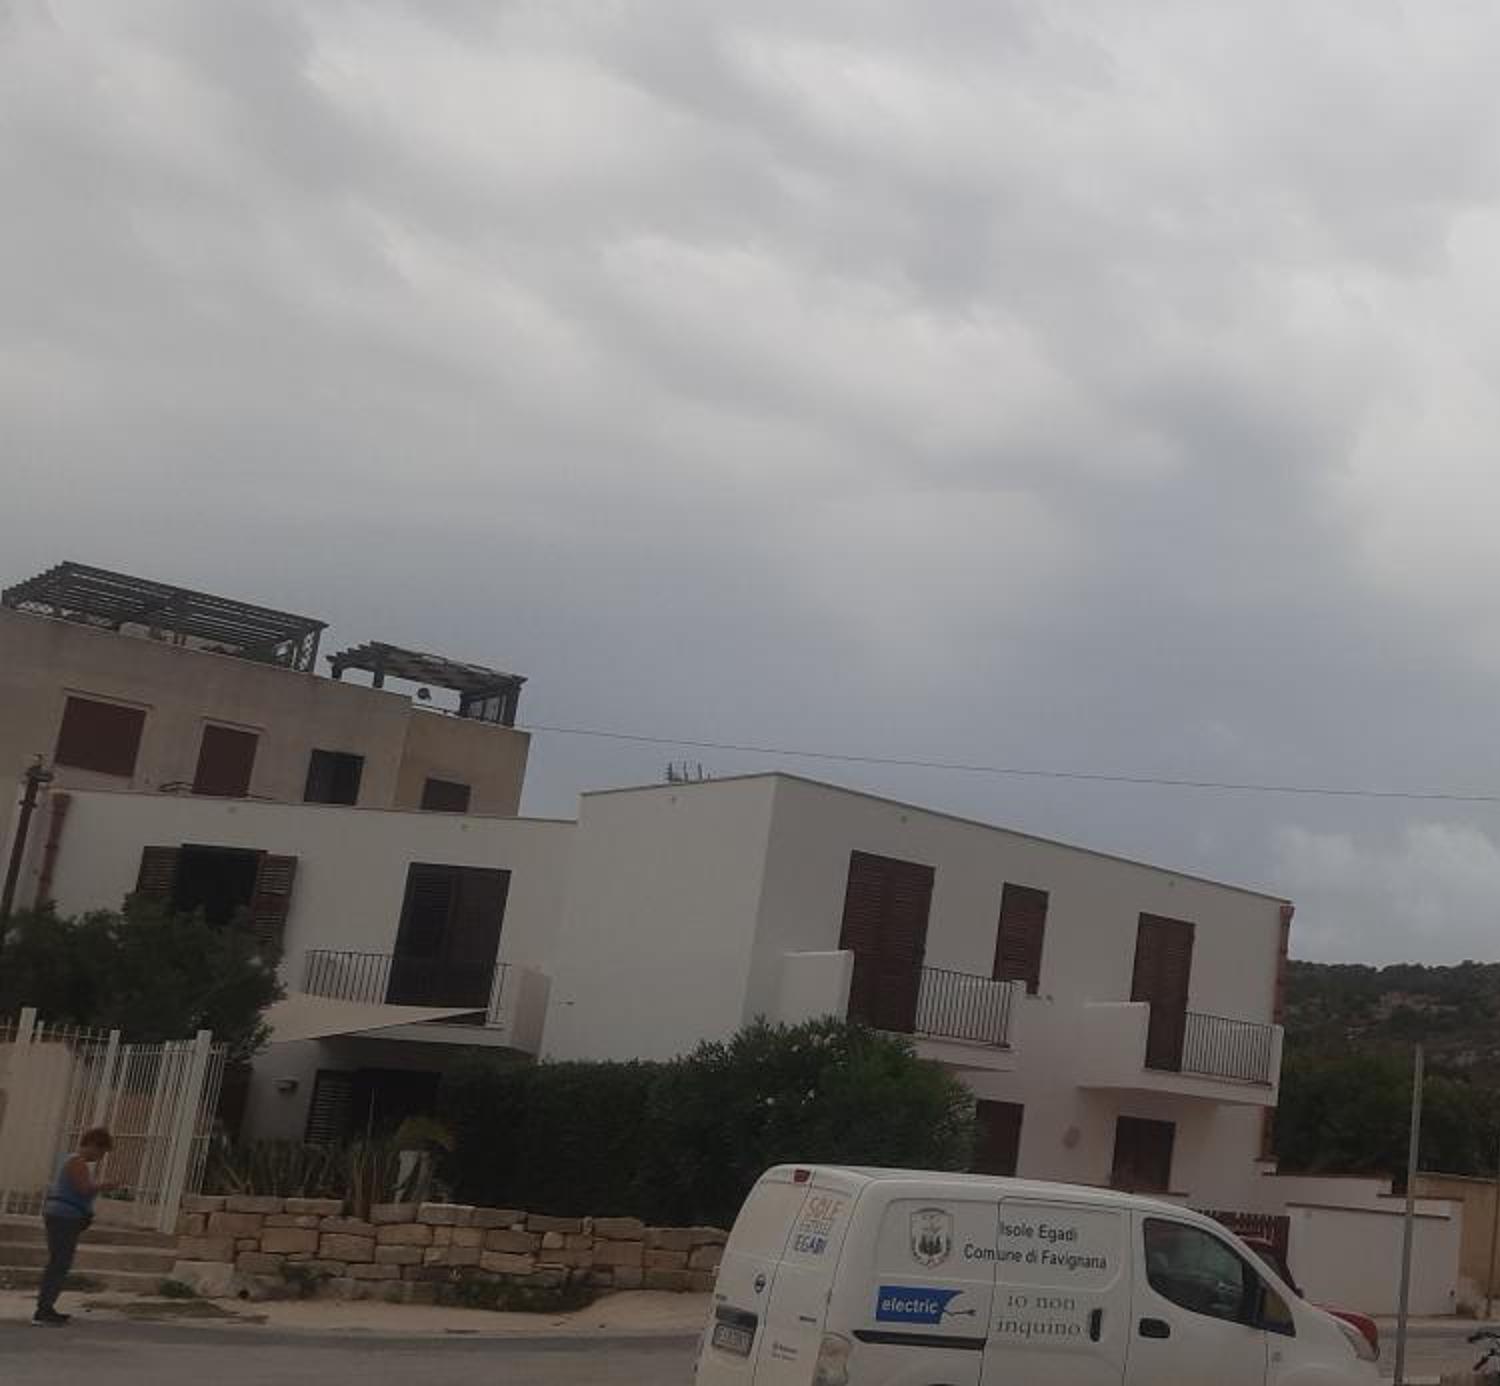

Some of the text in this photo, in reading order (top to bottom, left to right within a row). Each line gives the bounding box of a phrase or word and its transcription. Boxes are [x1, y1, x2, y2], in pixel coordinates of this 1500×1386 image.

[999, 1221, 1078, 1243] Isole Egadi
[963, 1244, 1107, 1271] Comune di Favignana
[881, 1296, 939, 1315] electric
[1036, 1297, 1076, 1311] non
